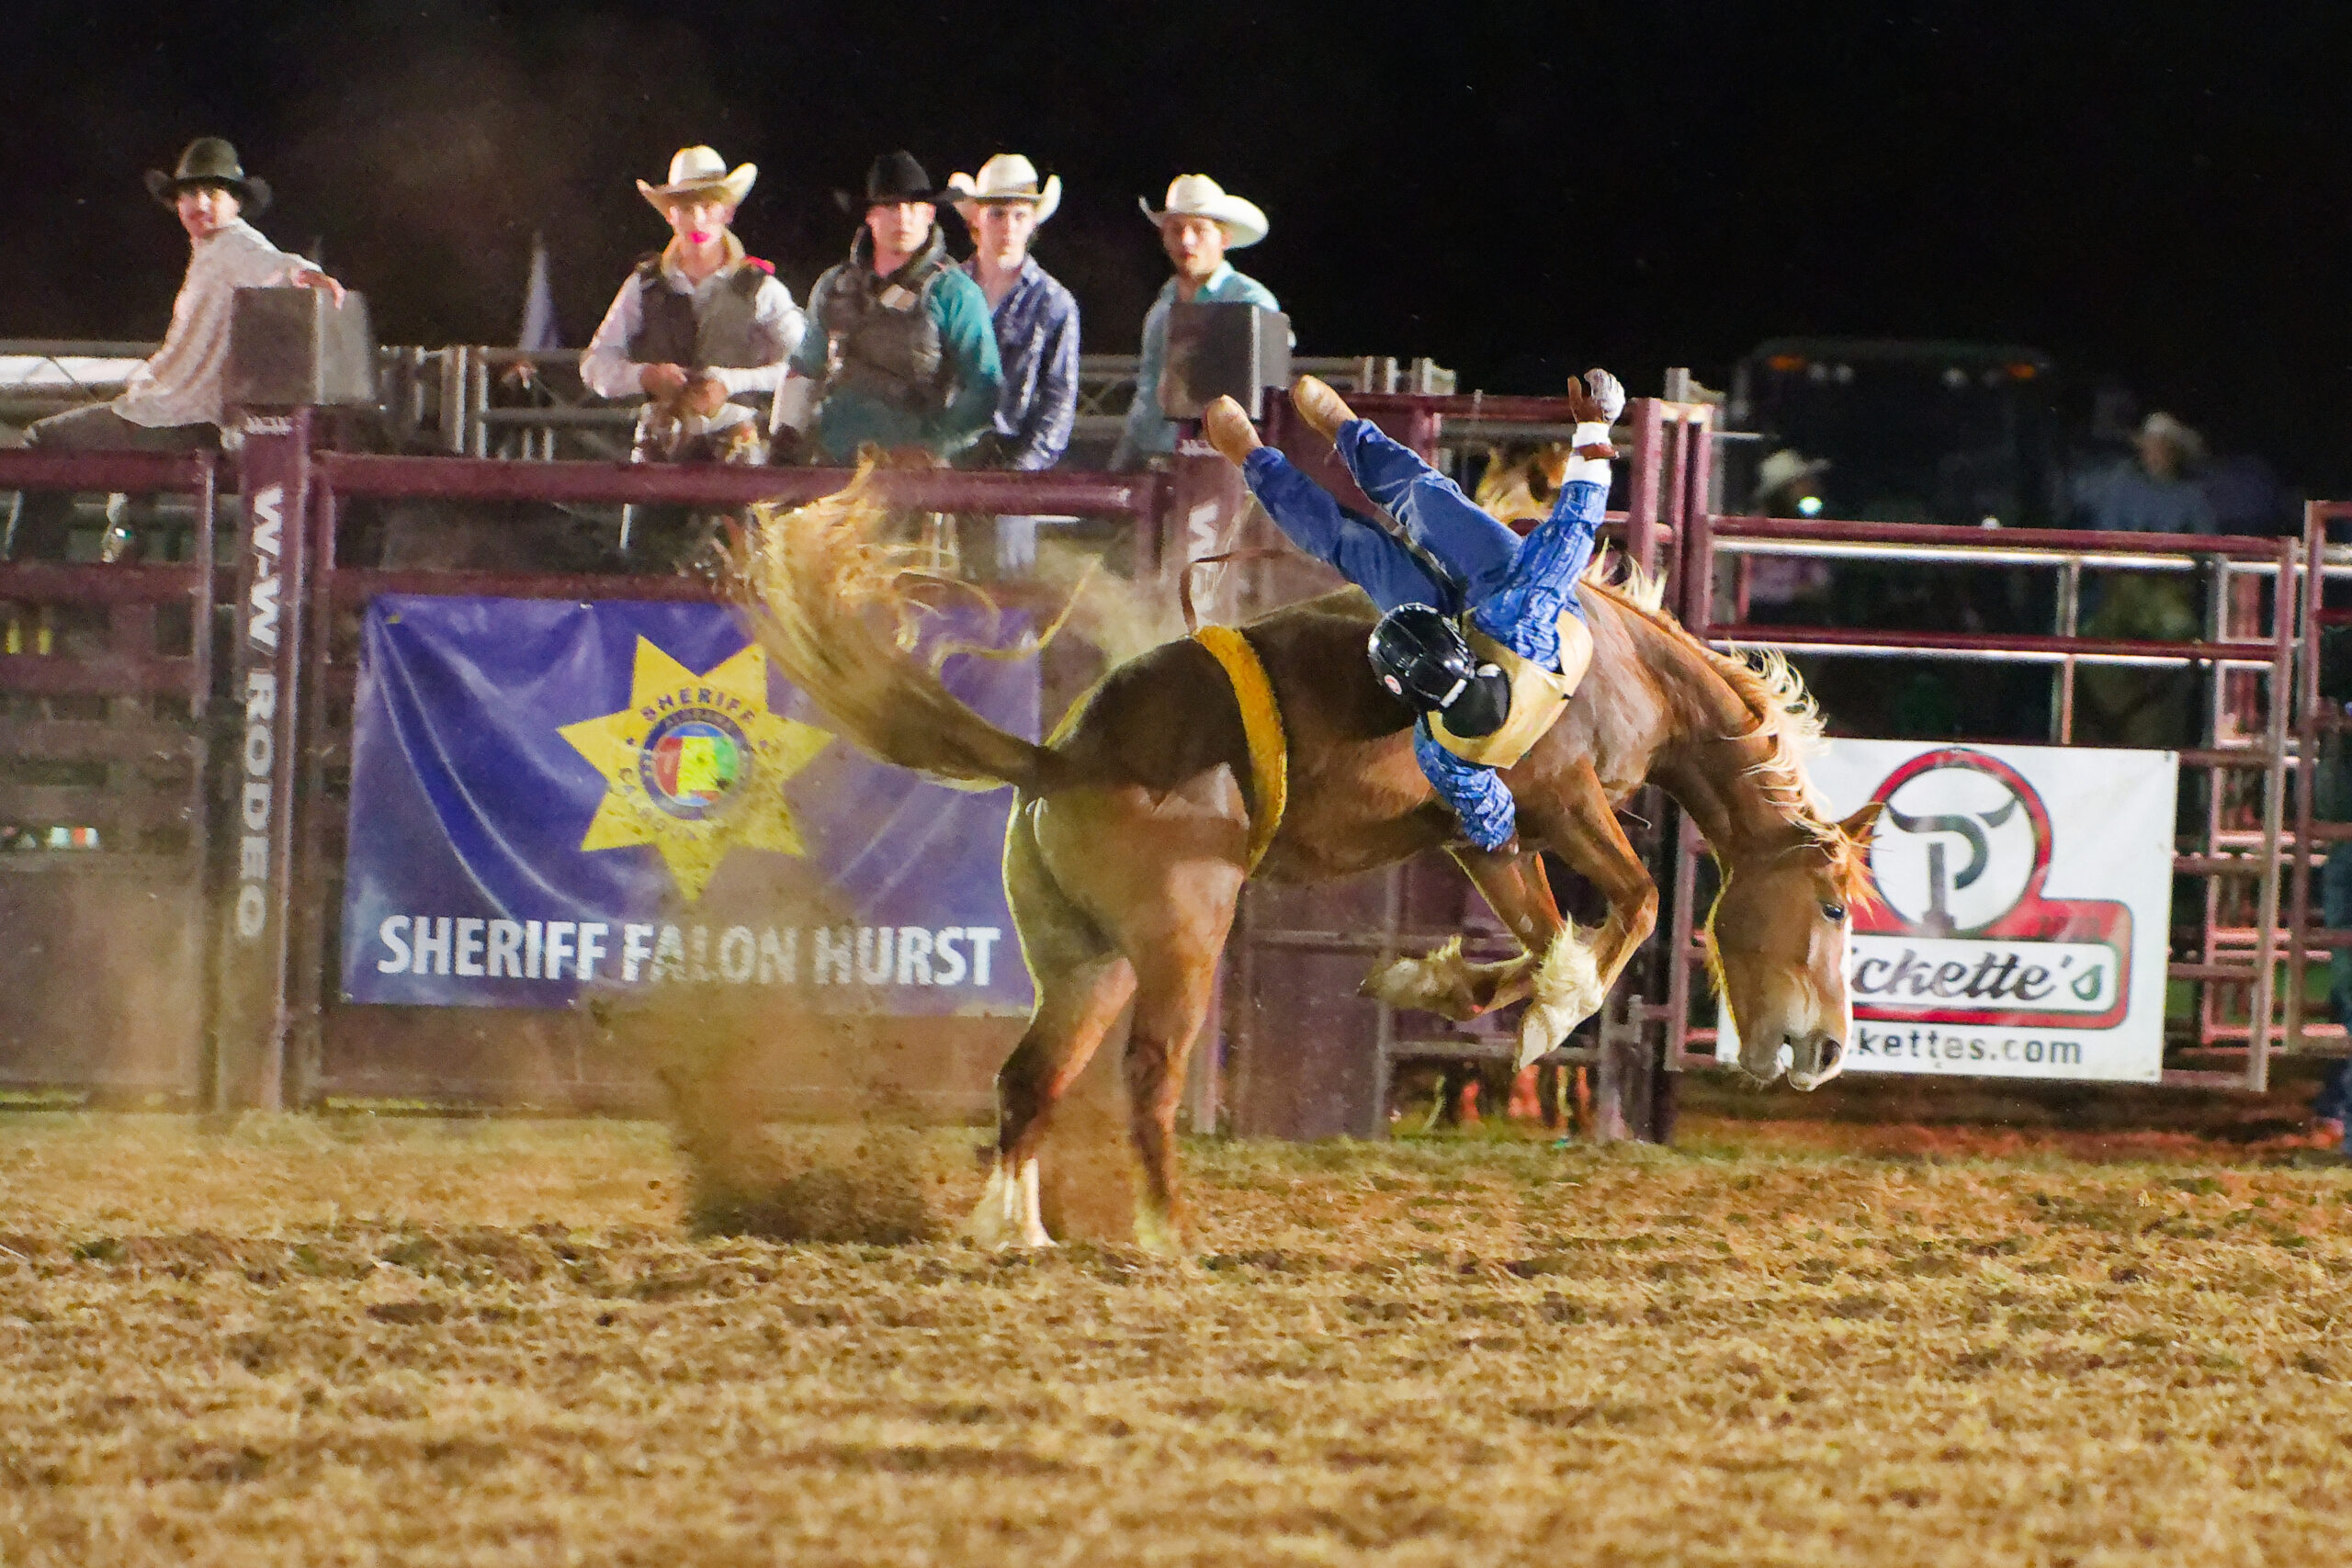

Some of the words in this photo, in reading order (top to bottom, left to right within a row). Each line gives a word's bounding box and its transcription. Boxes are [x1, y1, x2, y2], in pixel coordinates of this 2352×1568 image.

[639, 686, 756, 723] SHERIFF
[238, 670, 276, 938] RODEO
[377, 915, 610, 983] SHERIFF
[620, 923, 797, 984] FALON
[813, 926, 1001, 987] HURST
[1850, 948, 2105, 1001] ckette's
[1849, 1026, 2084, 1066] kettes.com
